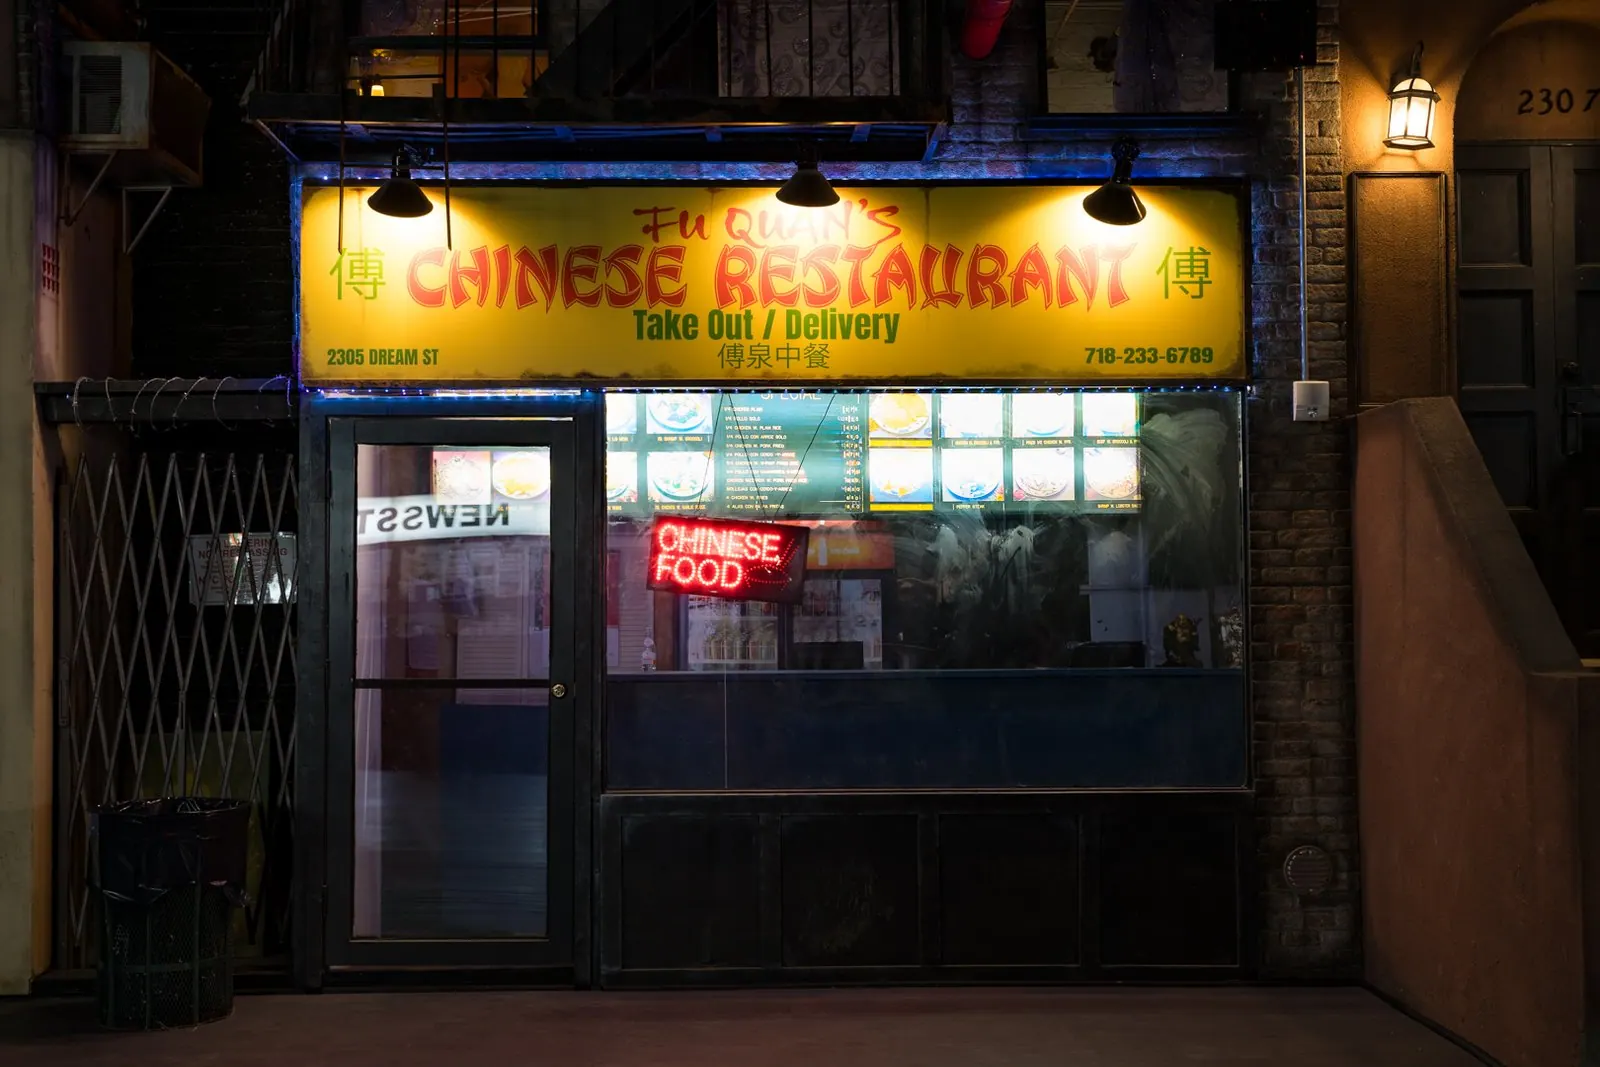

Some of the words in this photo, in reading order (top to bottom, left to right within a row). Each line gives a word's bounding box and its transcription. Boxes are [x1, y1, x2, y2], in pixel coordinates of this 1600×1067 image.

[1517, 87, 1600, 116] 2307
[328, 246, 387, 301] 傅
[406, 243, 688, 314] CHINESE
[714, 242, 1137, 312] RESTAURANT
[1155, 245, 1213, 300] 傅
[633, 308, 699, 342] Take
[708, 308, 754, 341] Out
[763, 309, 775, 341] /
[784, 307, 901, 344] Delivery
[326, 347, 366, 367] 2305
[368, 347, 416, 367] DREAM
[421, 347, 440, 367] ST
[716, 342, 831, 370] 傅泉中餐
[1084, 346, 1214, 365] 718-233-6789
[657, 523, 781, 563] CHINESE
[655, 553, 743, 589] FOOD
